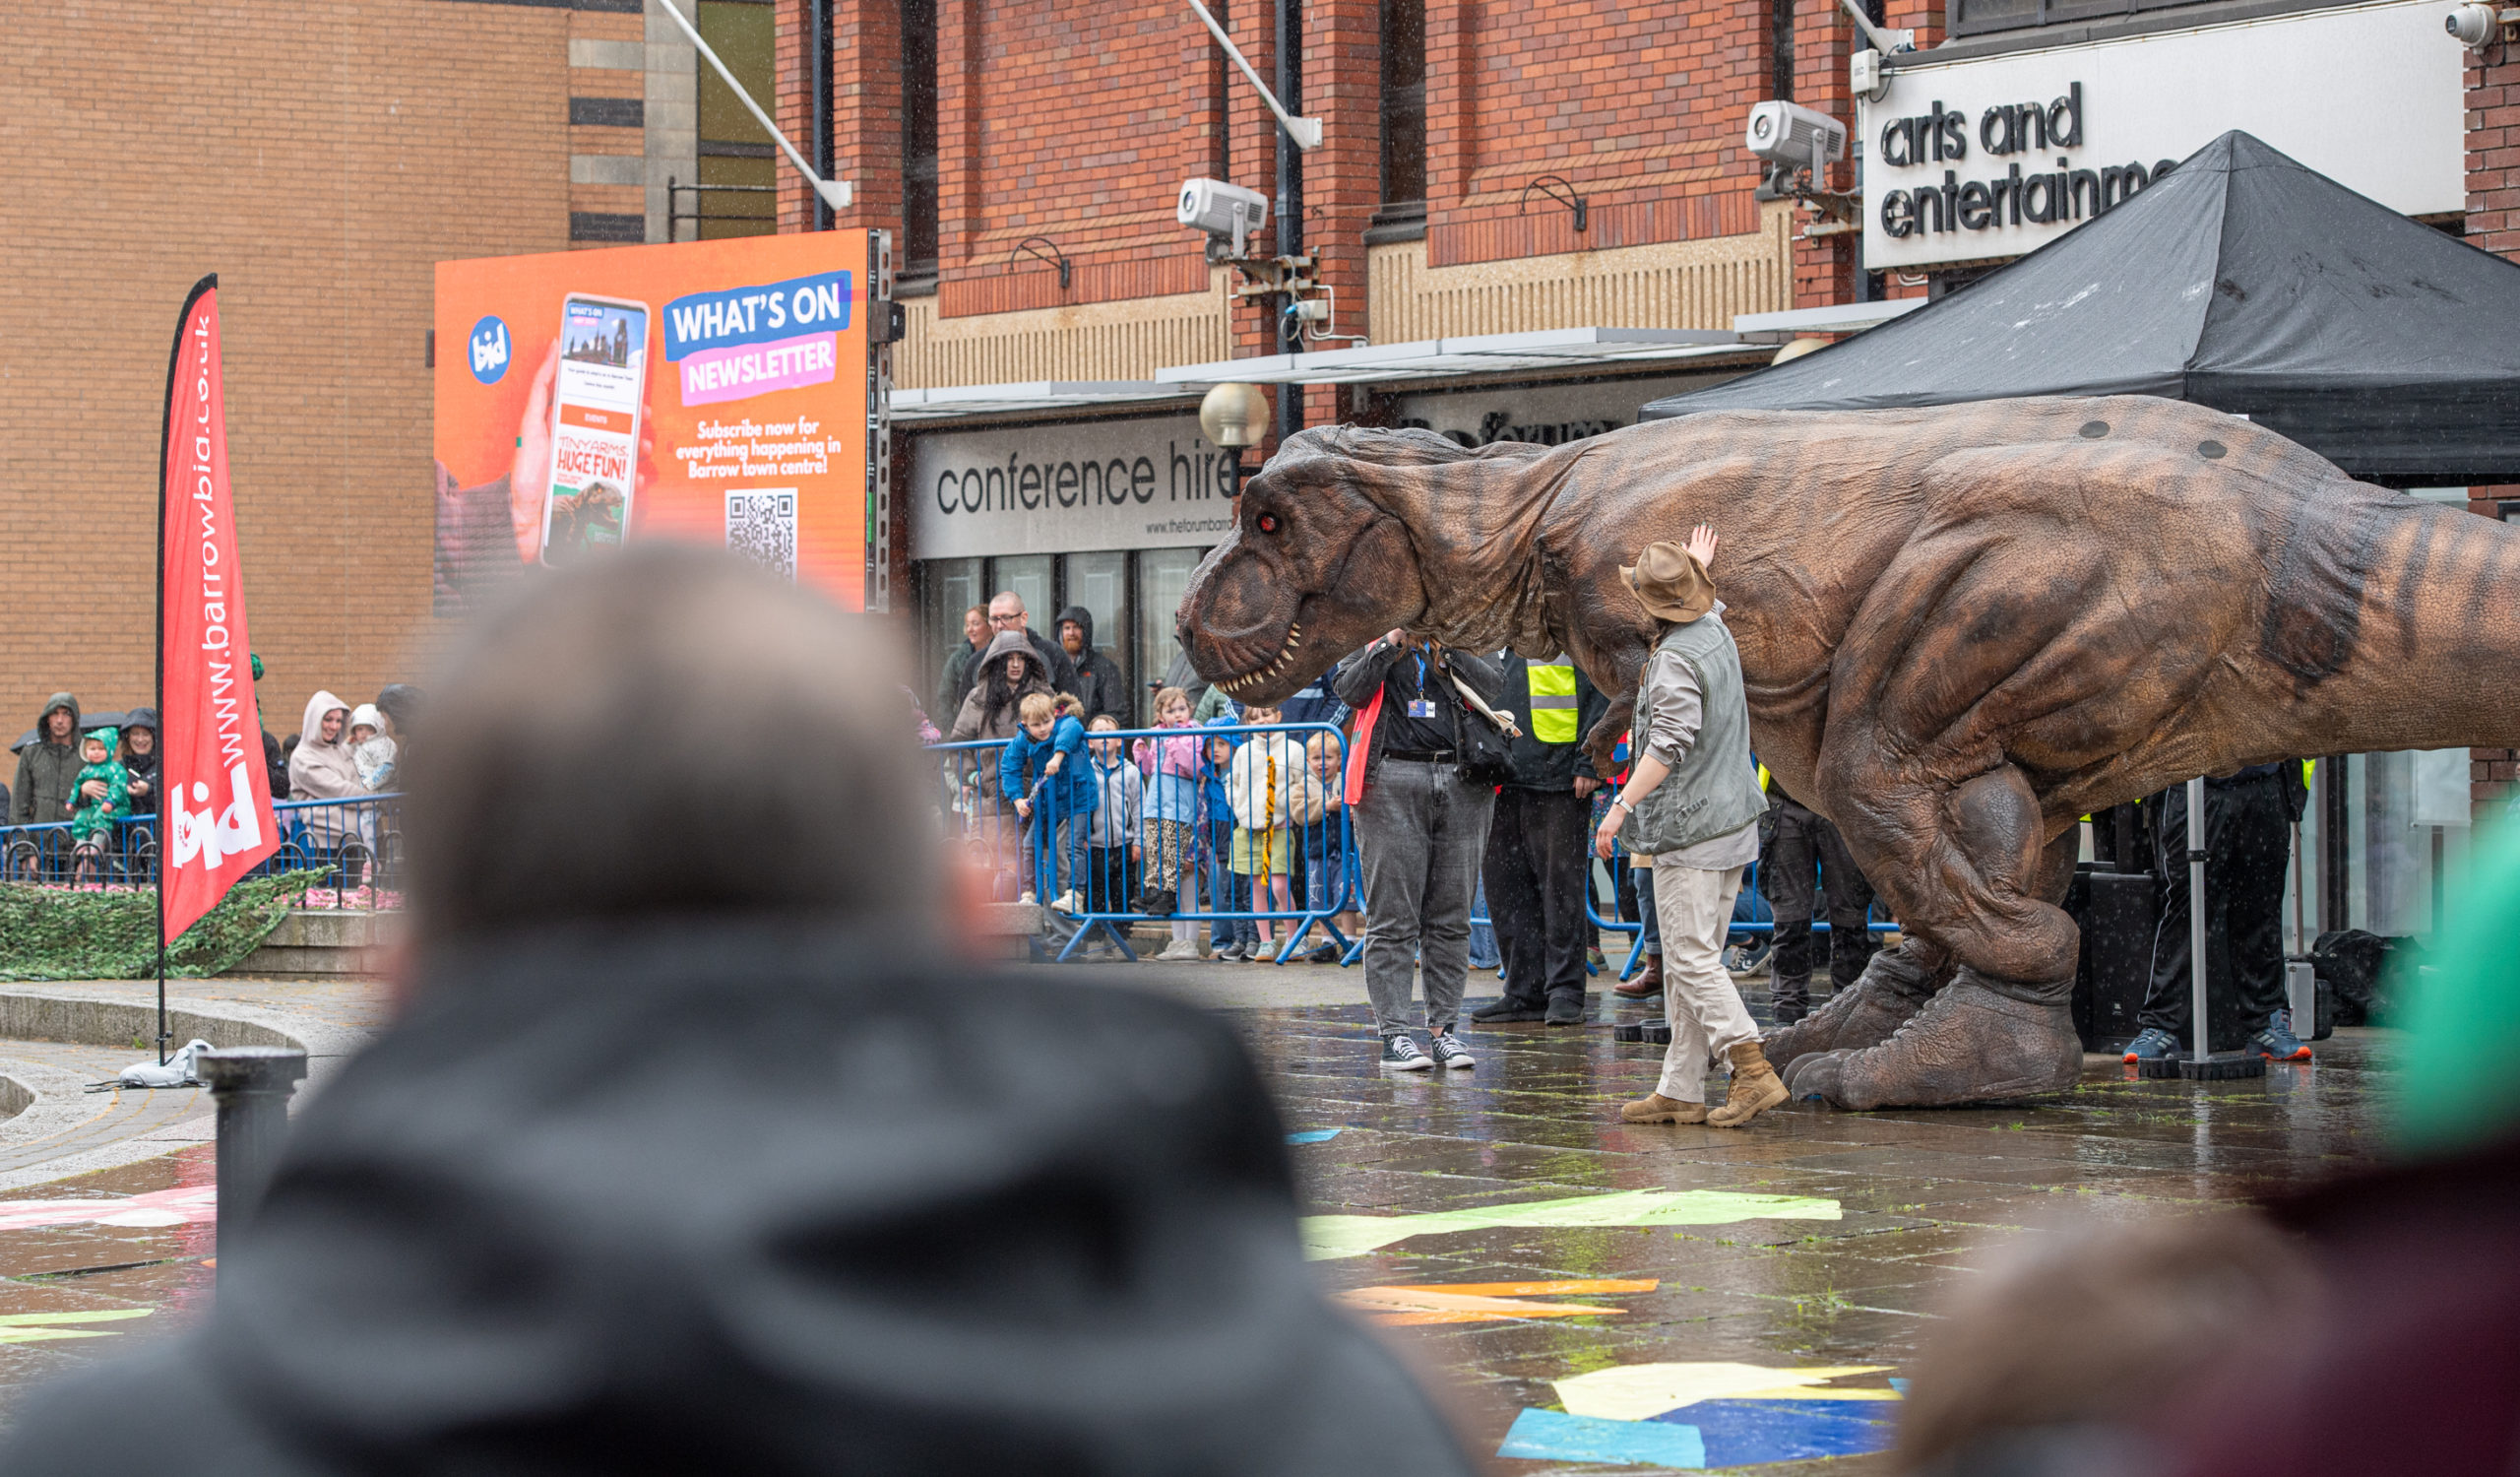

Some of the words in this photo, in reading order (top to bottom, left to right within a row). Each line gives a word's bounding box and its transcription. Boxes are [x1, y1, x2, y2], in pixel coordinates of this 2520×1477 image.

[1880, 99, 1968, 167] arts
[1979, 81, 2084, 156] and
[672, 291, 787, 343] WHAT'S
[791, 283, 841, 325] ON
[472, 322, 508, 373] bid
[688, 340, 835, 394] NEWSLETTER
[558, 435, 591, 450] TINY
[676, 438, 749, 464] everything
[751, 436, 825, 461] happening
[828, 435, 842, 454] in
[697, 418, 763, 440] Subscribe
[765, 422, 796, 436] now
[798, 416, 819, 435] for
[557, 448, 591, 475] HUGE
[593, 454, 628, 482] FUN!
[688, 460, 740, 479] Barrow
[742, 460, 778, 478] town
[780, 455, 828, 476] centre!
[937, 451, 1156, 515] conference
[1169, 438, 1232, 501] hire
[170, 761, 263, 871] bid
